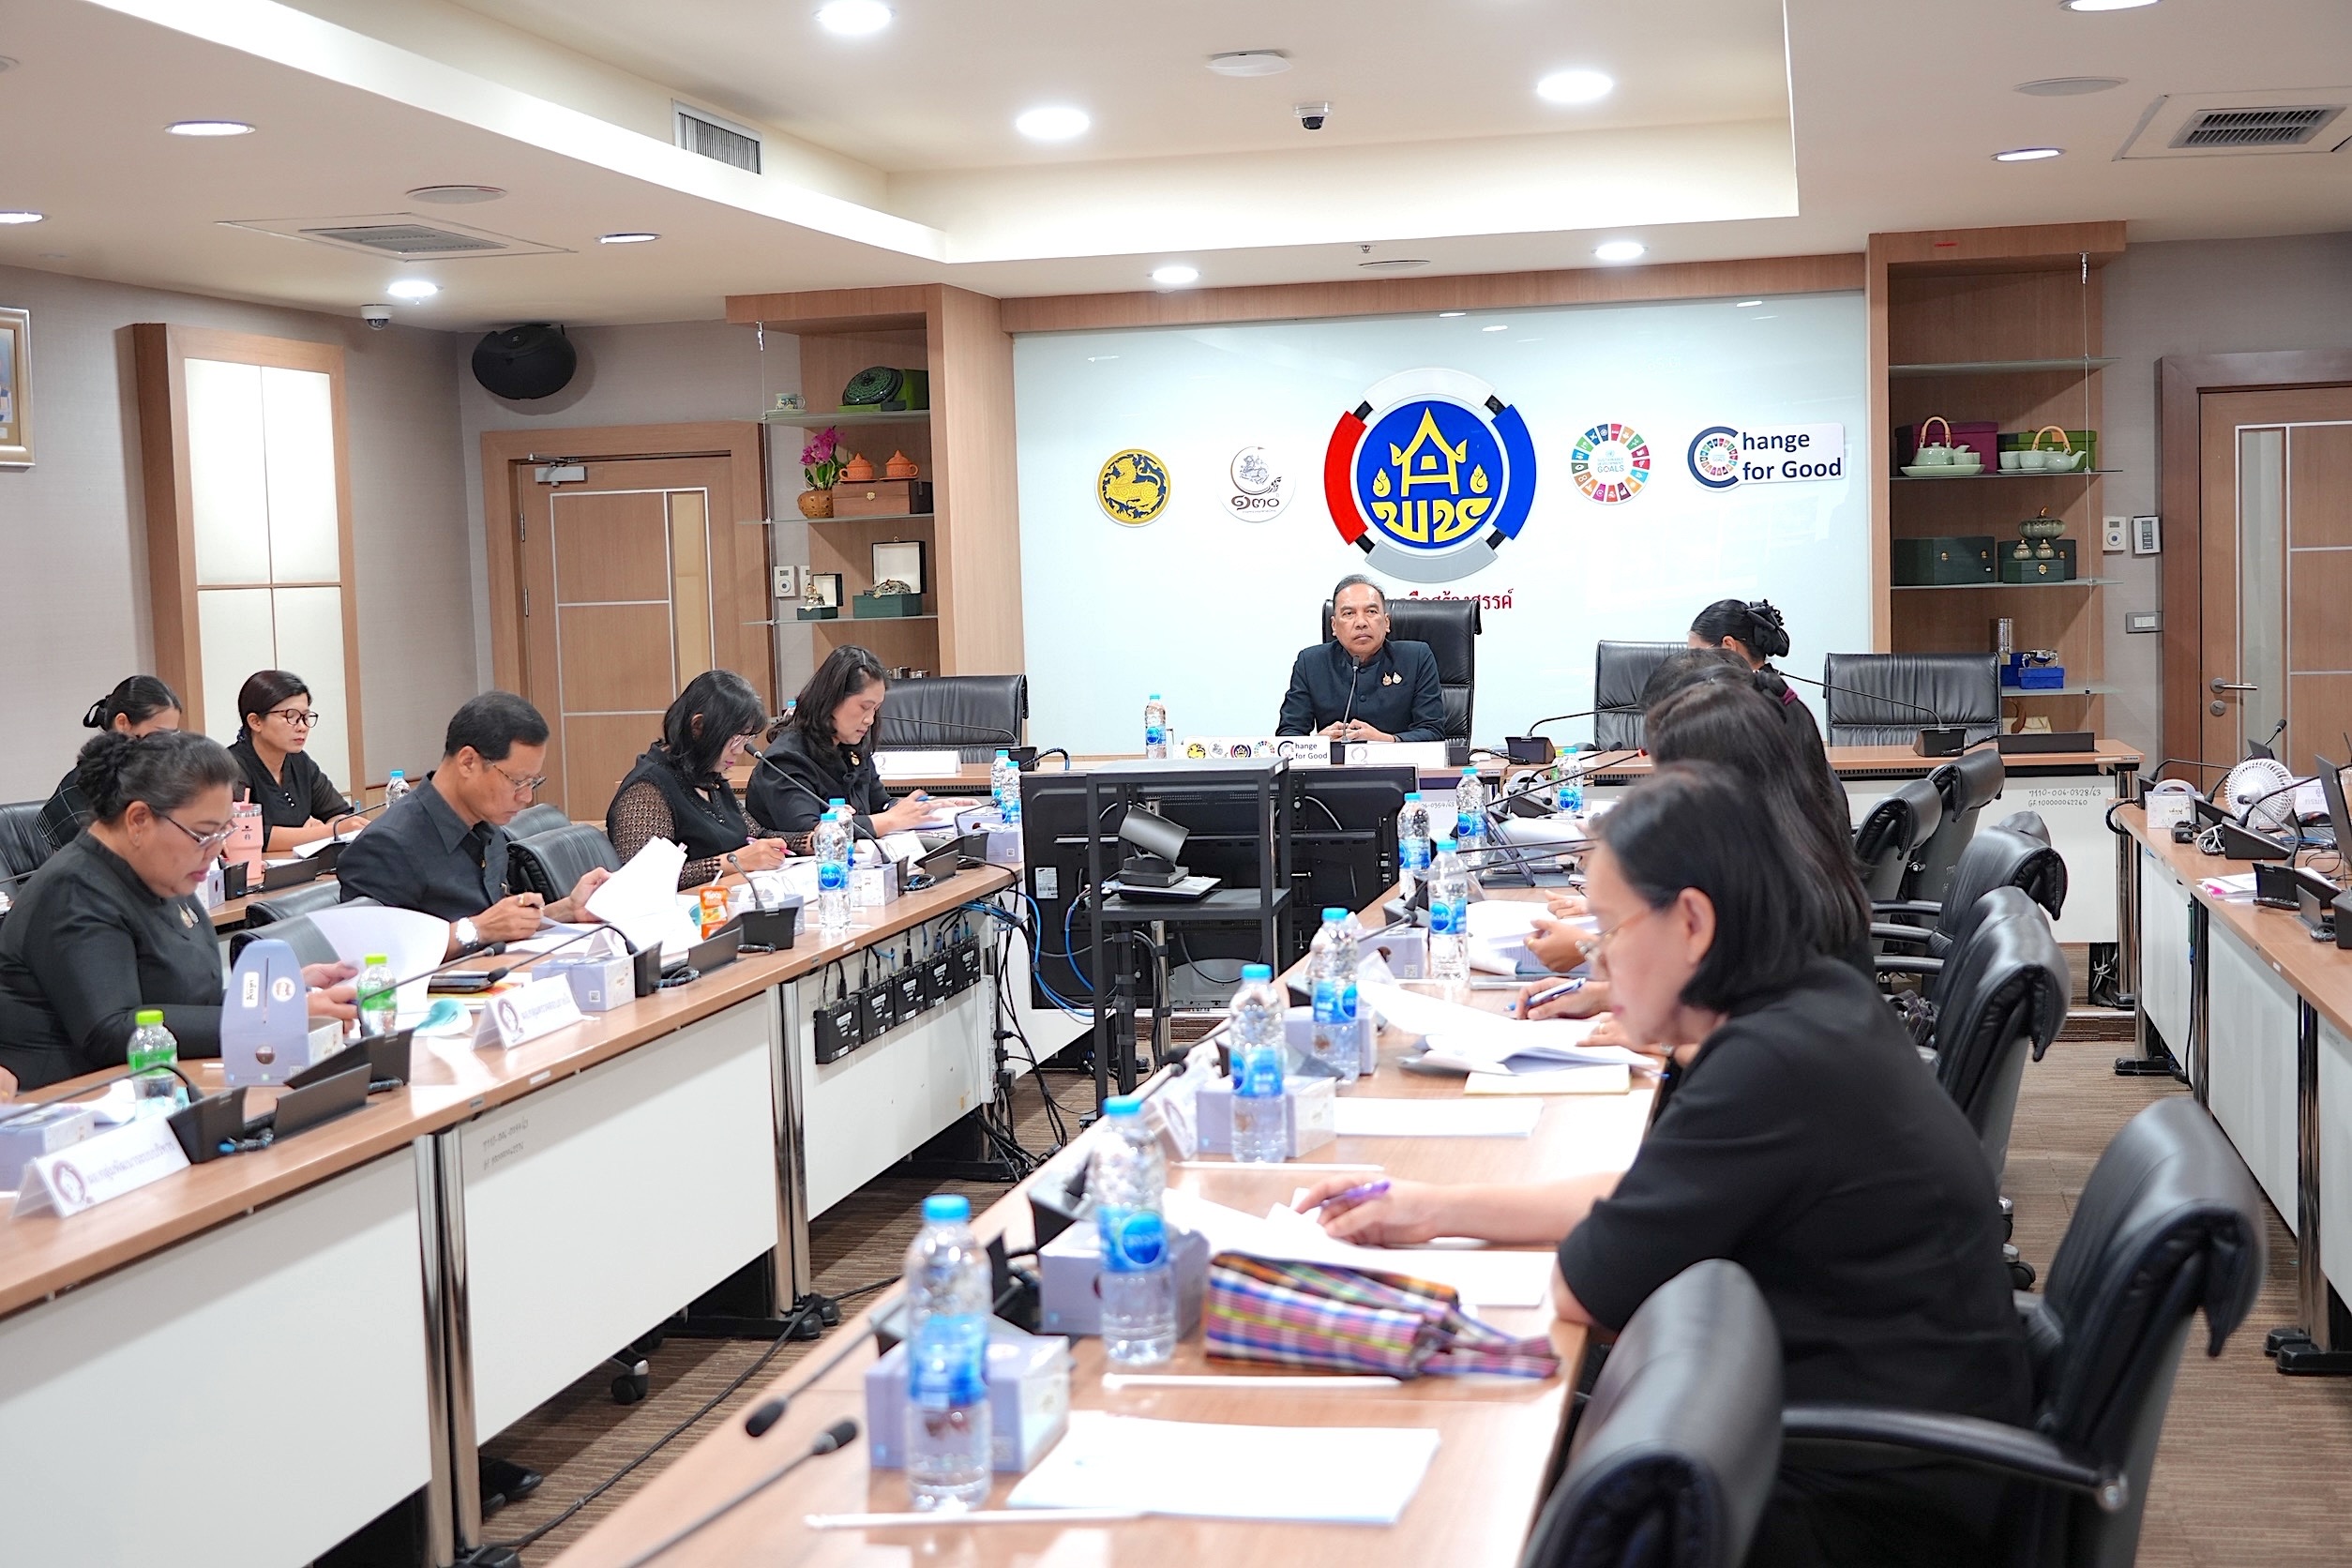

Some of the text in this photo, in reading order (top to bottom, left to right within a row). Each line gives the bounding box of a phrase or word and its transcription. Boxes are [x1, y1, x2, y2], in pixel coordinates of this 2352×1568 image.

[1597, 464, 1625, 473] GOALS
[1742, 457, 1841, 480] for Good
